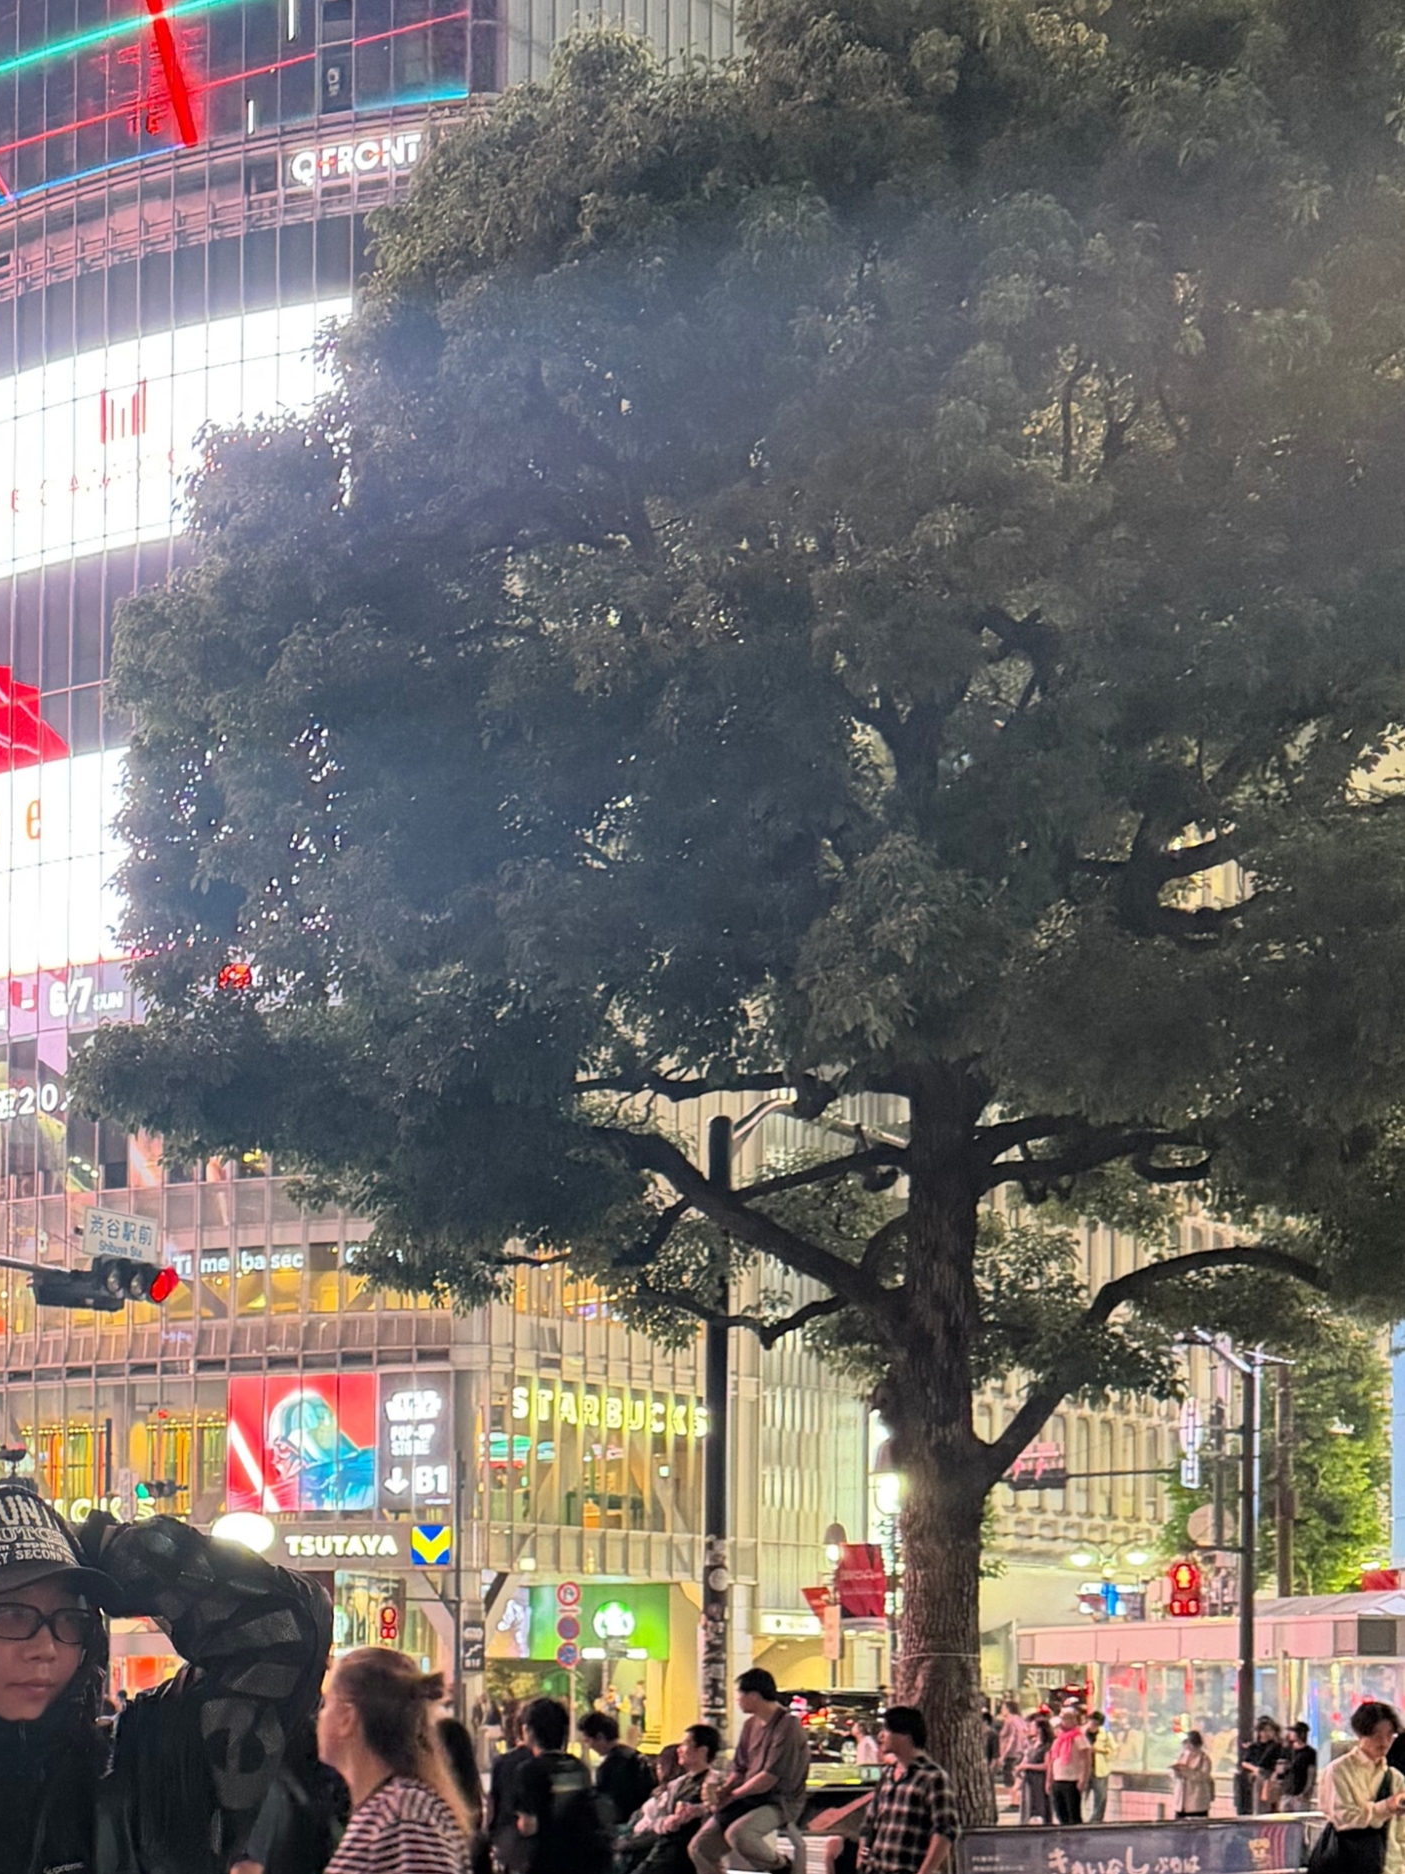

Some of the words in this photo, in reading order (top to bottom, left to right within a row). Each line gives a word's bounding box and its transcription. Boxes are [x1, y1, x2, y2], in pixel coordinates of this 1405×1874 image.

[291, 134, 421, 187] QFRONT
[48, 976, 93, 1017] 6/7
[92, 991, 124, 1012] SUN
[88, 1213, 154, 1247] 渋谷駅前
[97, 1239, 128, 1255] Shibuya
[512, 1386, 709, 1438] STARBUCKS
[390, 1423, 436, 1440] POP-UP
[390, 1440, 431, 1456] STORE
[414, 1465, 449, 1494] B1
[15, 1548, 63, 1562] SECOND
[285, 1534, 398, 1558] TSUTAYA
